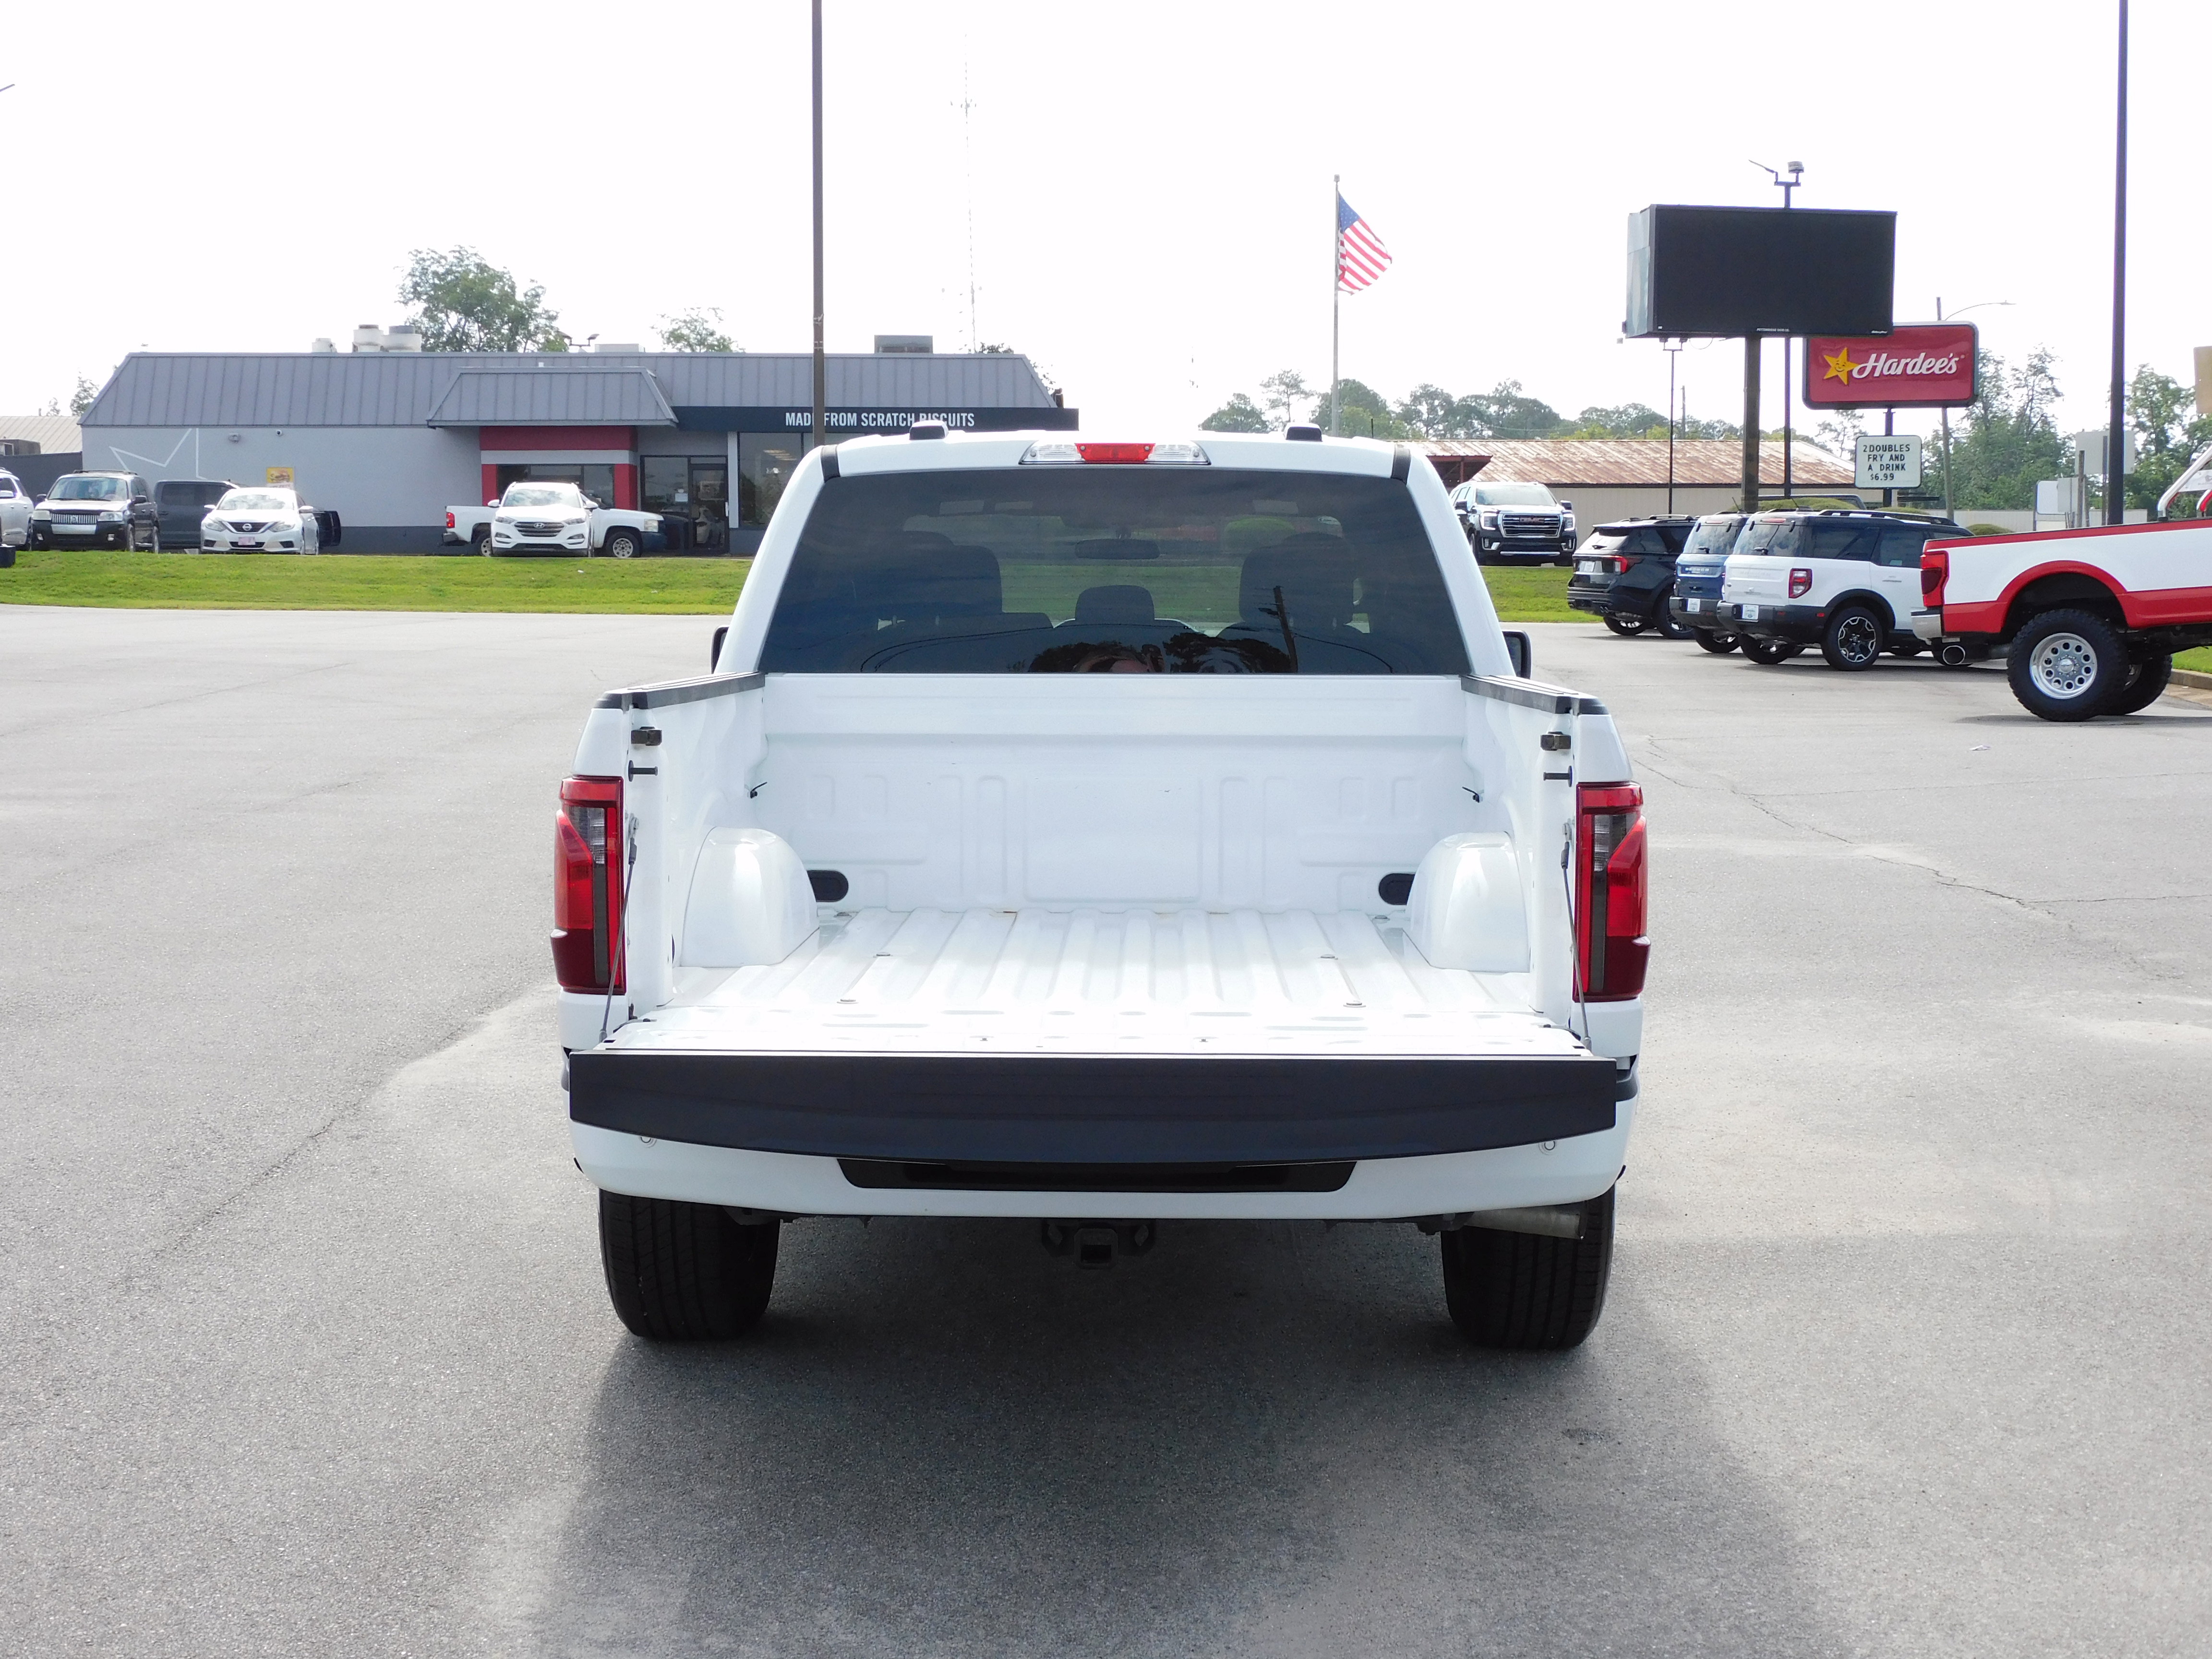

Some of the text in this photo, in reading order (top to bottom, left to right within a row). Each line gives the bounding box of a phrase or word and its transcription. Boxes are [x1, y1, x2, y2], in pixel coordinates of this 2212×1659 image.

[1852, 352, 1960, 378] Hardee's
[785, 413, 814, 426] MAD
[824, 413, 857, 426] FROM
[861, 413, 914, 427] SCRATCH
[1880, 463, 1906, 471] DRINK
